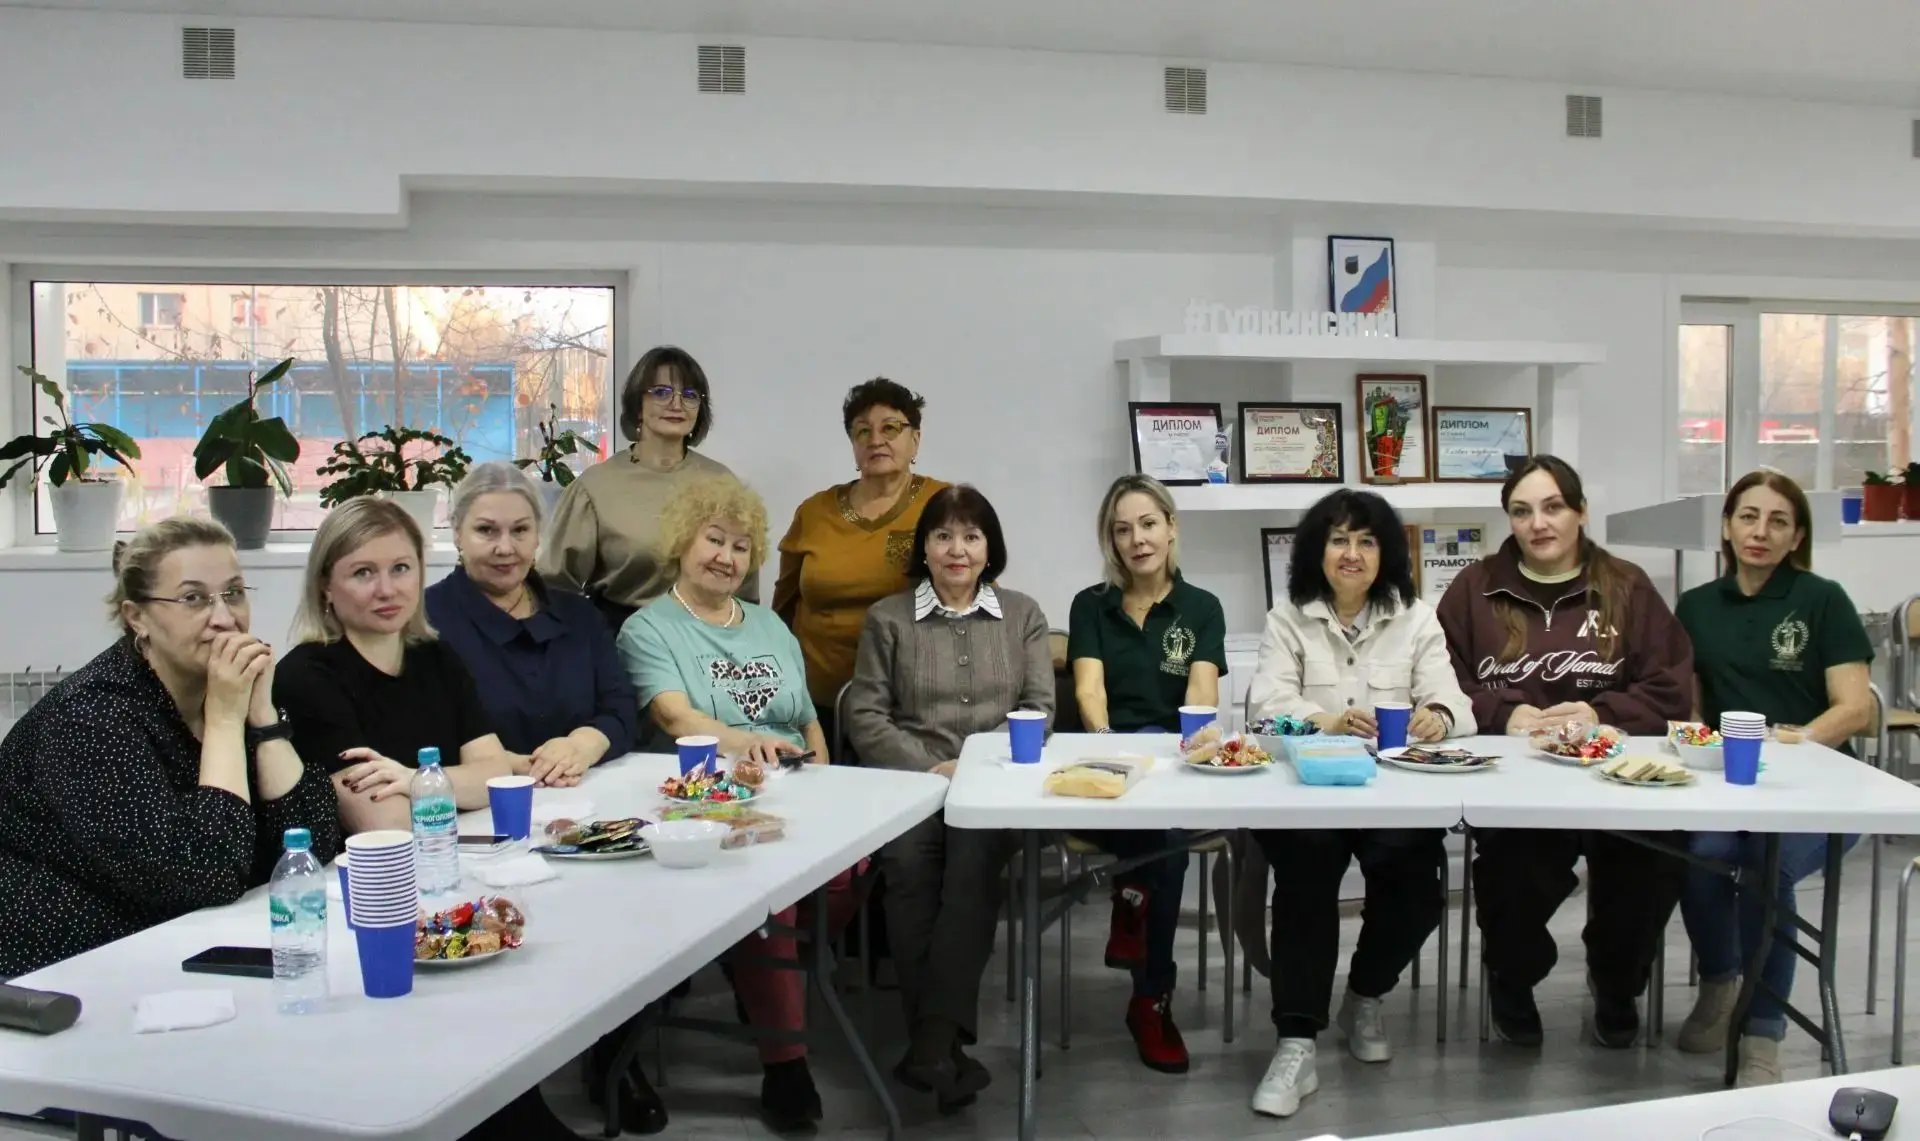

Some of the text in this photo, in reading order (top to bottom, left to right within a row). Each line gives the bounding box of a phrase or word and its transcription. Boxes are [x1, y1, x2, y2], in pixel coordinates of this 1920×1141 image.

[1152, 419, 1202, 433] ДИПЛОМ
[1440, 419, 1489, 430] ДИПЛОМ
[1256, 426, 1300, 436] ДИПЛОМ
[1424, 558, 1480, 569] ГРАМОТ
[1541, 650, 1625, 682] Yamal
